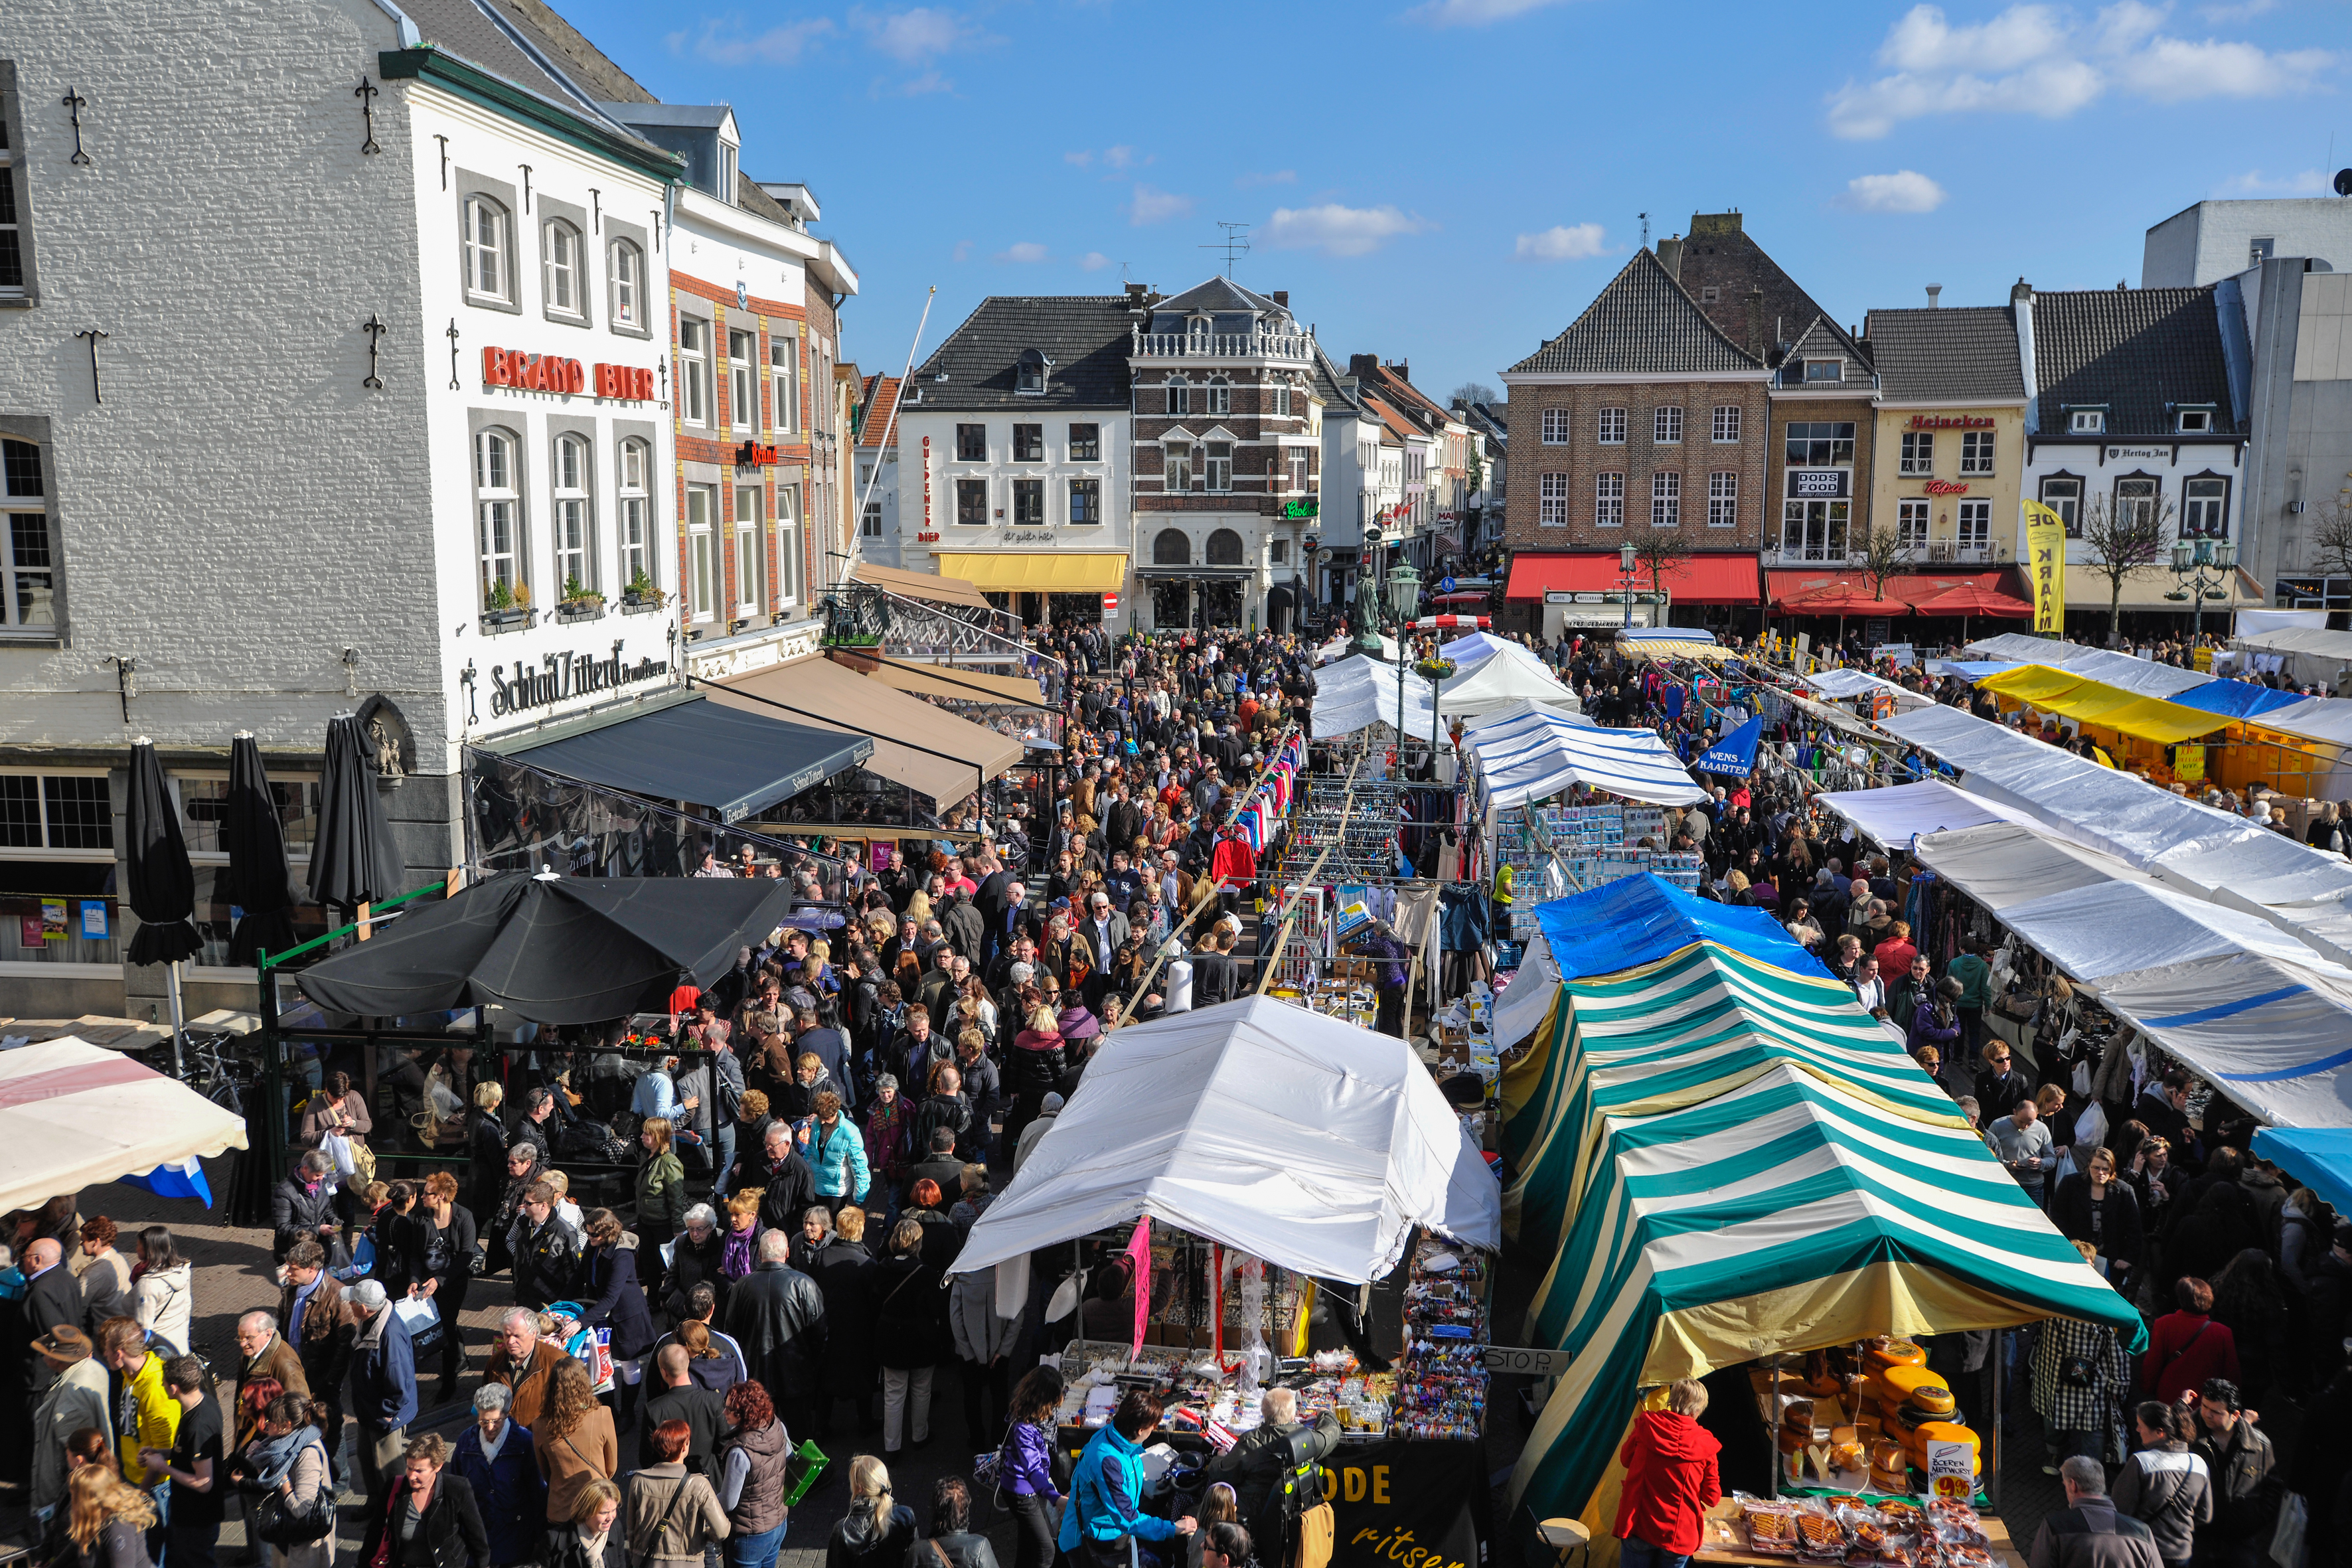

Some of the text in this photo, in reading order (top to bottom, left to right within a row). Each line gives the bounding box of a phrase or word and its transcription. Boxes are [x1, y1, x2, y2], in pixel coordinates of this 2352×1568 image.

[483, 346, 655, 400] BRAND BIER
[1912, 415, 1995, 428] Heineken
[751, 439, 777, 468] Brand
[2121, 449, 2169, 459] Hertog Jan
[922, 435, 931, 526] GULPENER
[1924, 479, 1970, 497] Tapas
[1287, 501, 1320, 520] Grolsch
[918, 532, 941, 542] BIER
[1004, 530, 1055, 544] der gulden haen
[1709, 751, 1739, 763] WENS
[1699, 760, 1749, 775] KAARTEN
[726, 802, 749, 824] Eetcafé
[1932, 1458, 1964, 1467] BOEREN
[1932, 1466, 1972, 1475] METWORST
